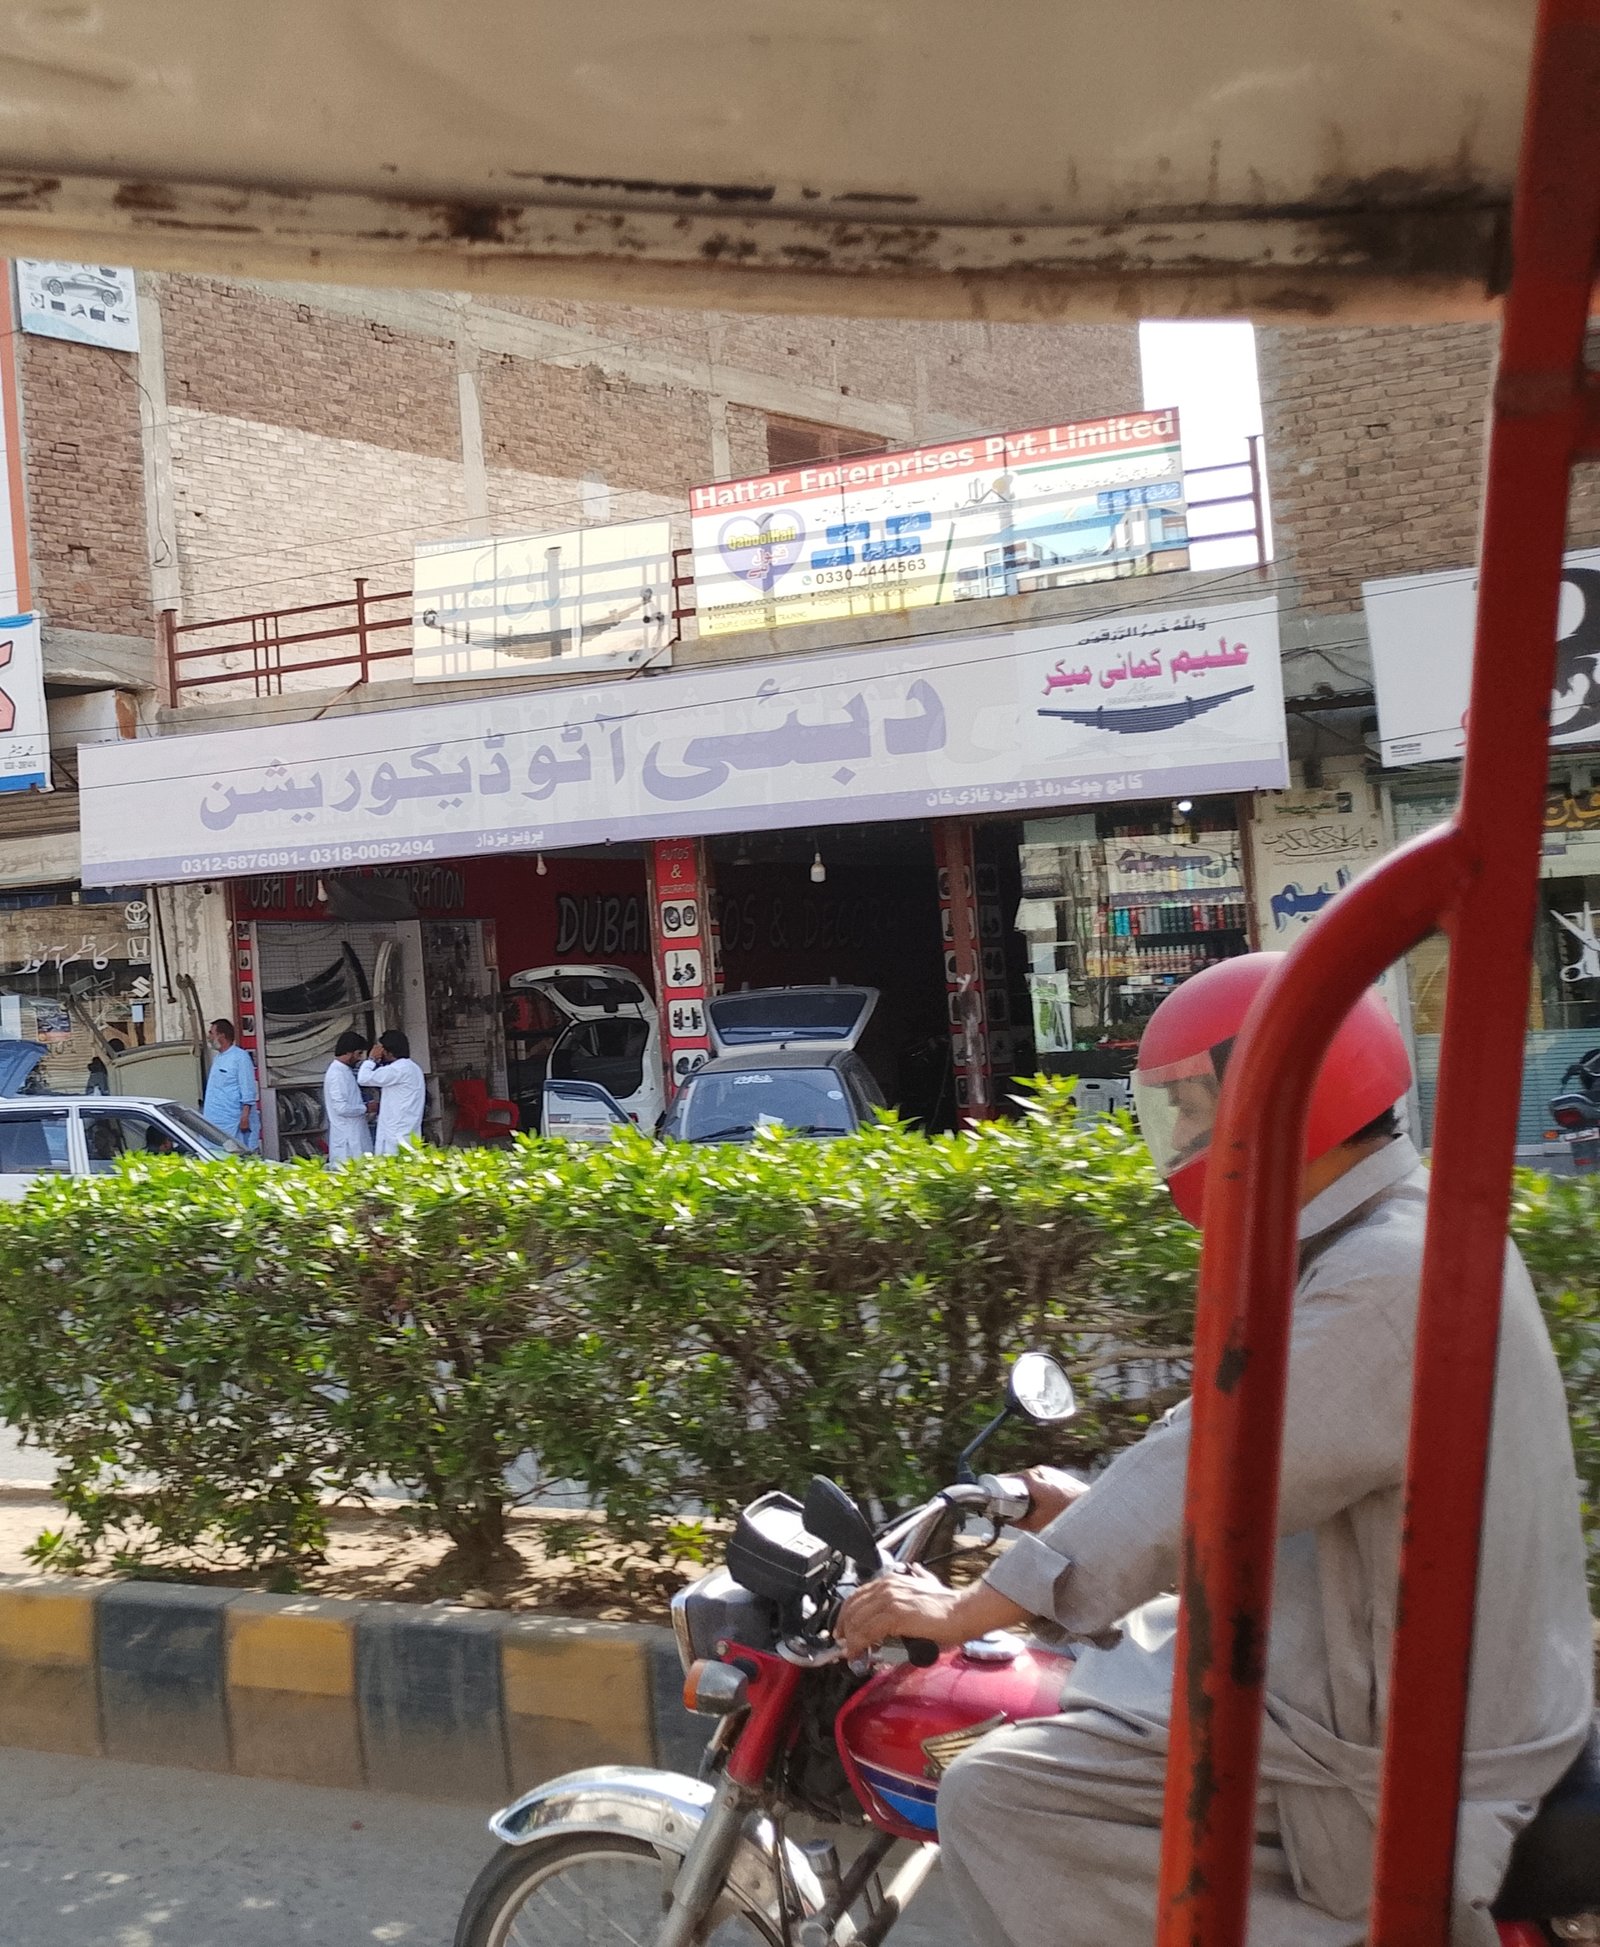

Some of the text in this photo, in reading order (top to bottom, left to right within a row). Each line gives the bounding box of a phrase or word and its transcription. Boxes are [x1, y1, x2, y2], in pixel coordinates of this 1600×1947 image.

[695, 480, 790, 508] Hattar
[800, 447, 974, 487] Enterprises
[1049, 410, 1173, 451] Limited
[816, 558, 927, 585] 0330-4444563
[1041, 659, 1093, 696] میکر
[1098, 649, 1162, 689] کمانی
[1170, 637, 1249, 684] علیم
[522, 708, 639, 800] آٹو
[309, 838, 436, 864] 0318-0062494
[59, 934, 120, 985] کاظم
